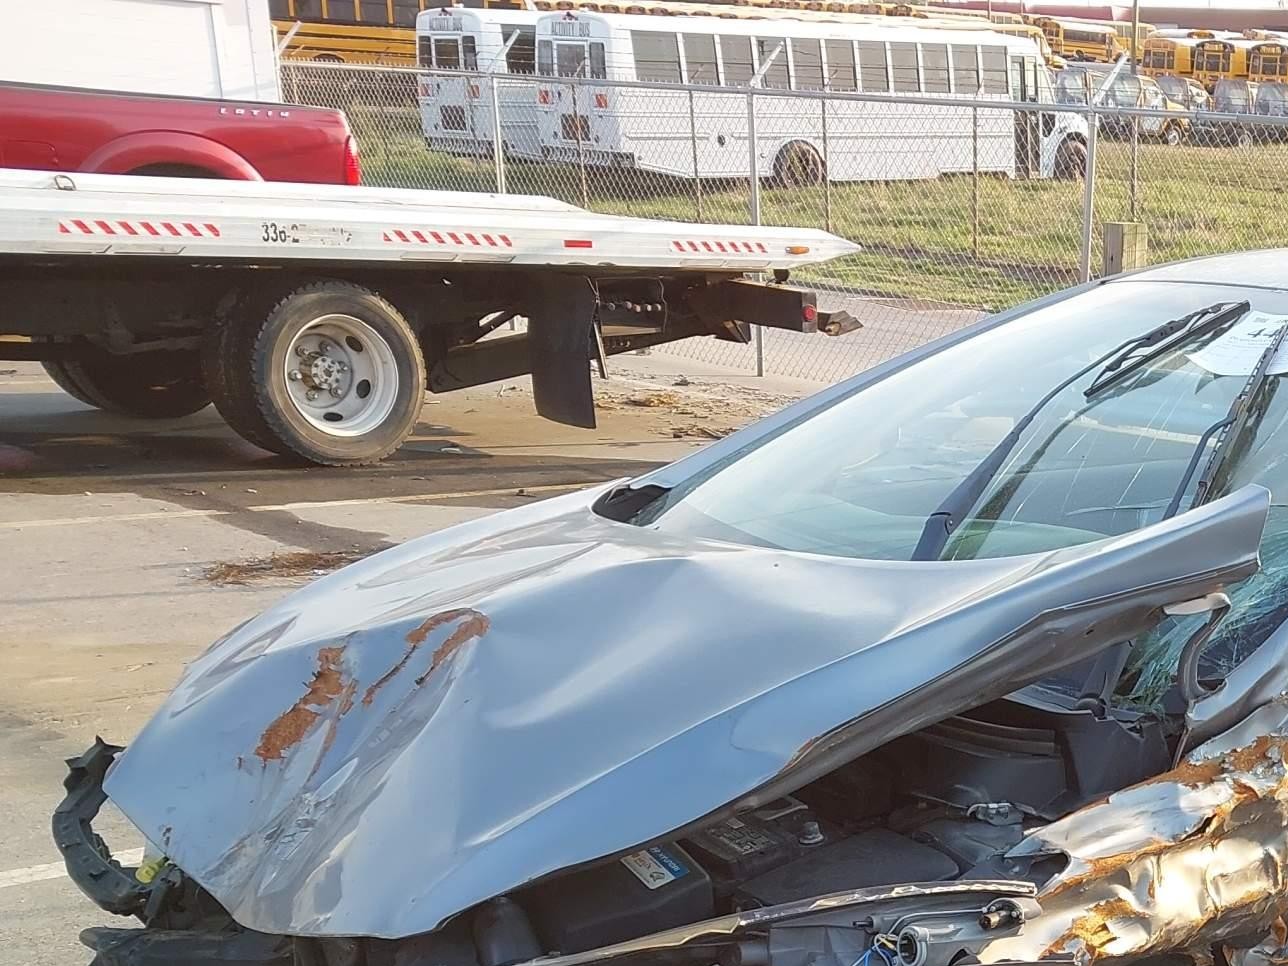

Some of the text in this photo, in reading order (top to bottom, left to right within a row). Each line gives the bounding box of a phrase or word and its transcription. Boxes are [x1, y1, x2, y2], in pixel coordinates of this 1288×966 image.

[452, 17, 463, 32] BUS
[551, 22, 590, 37] ACTIVITY BUS
